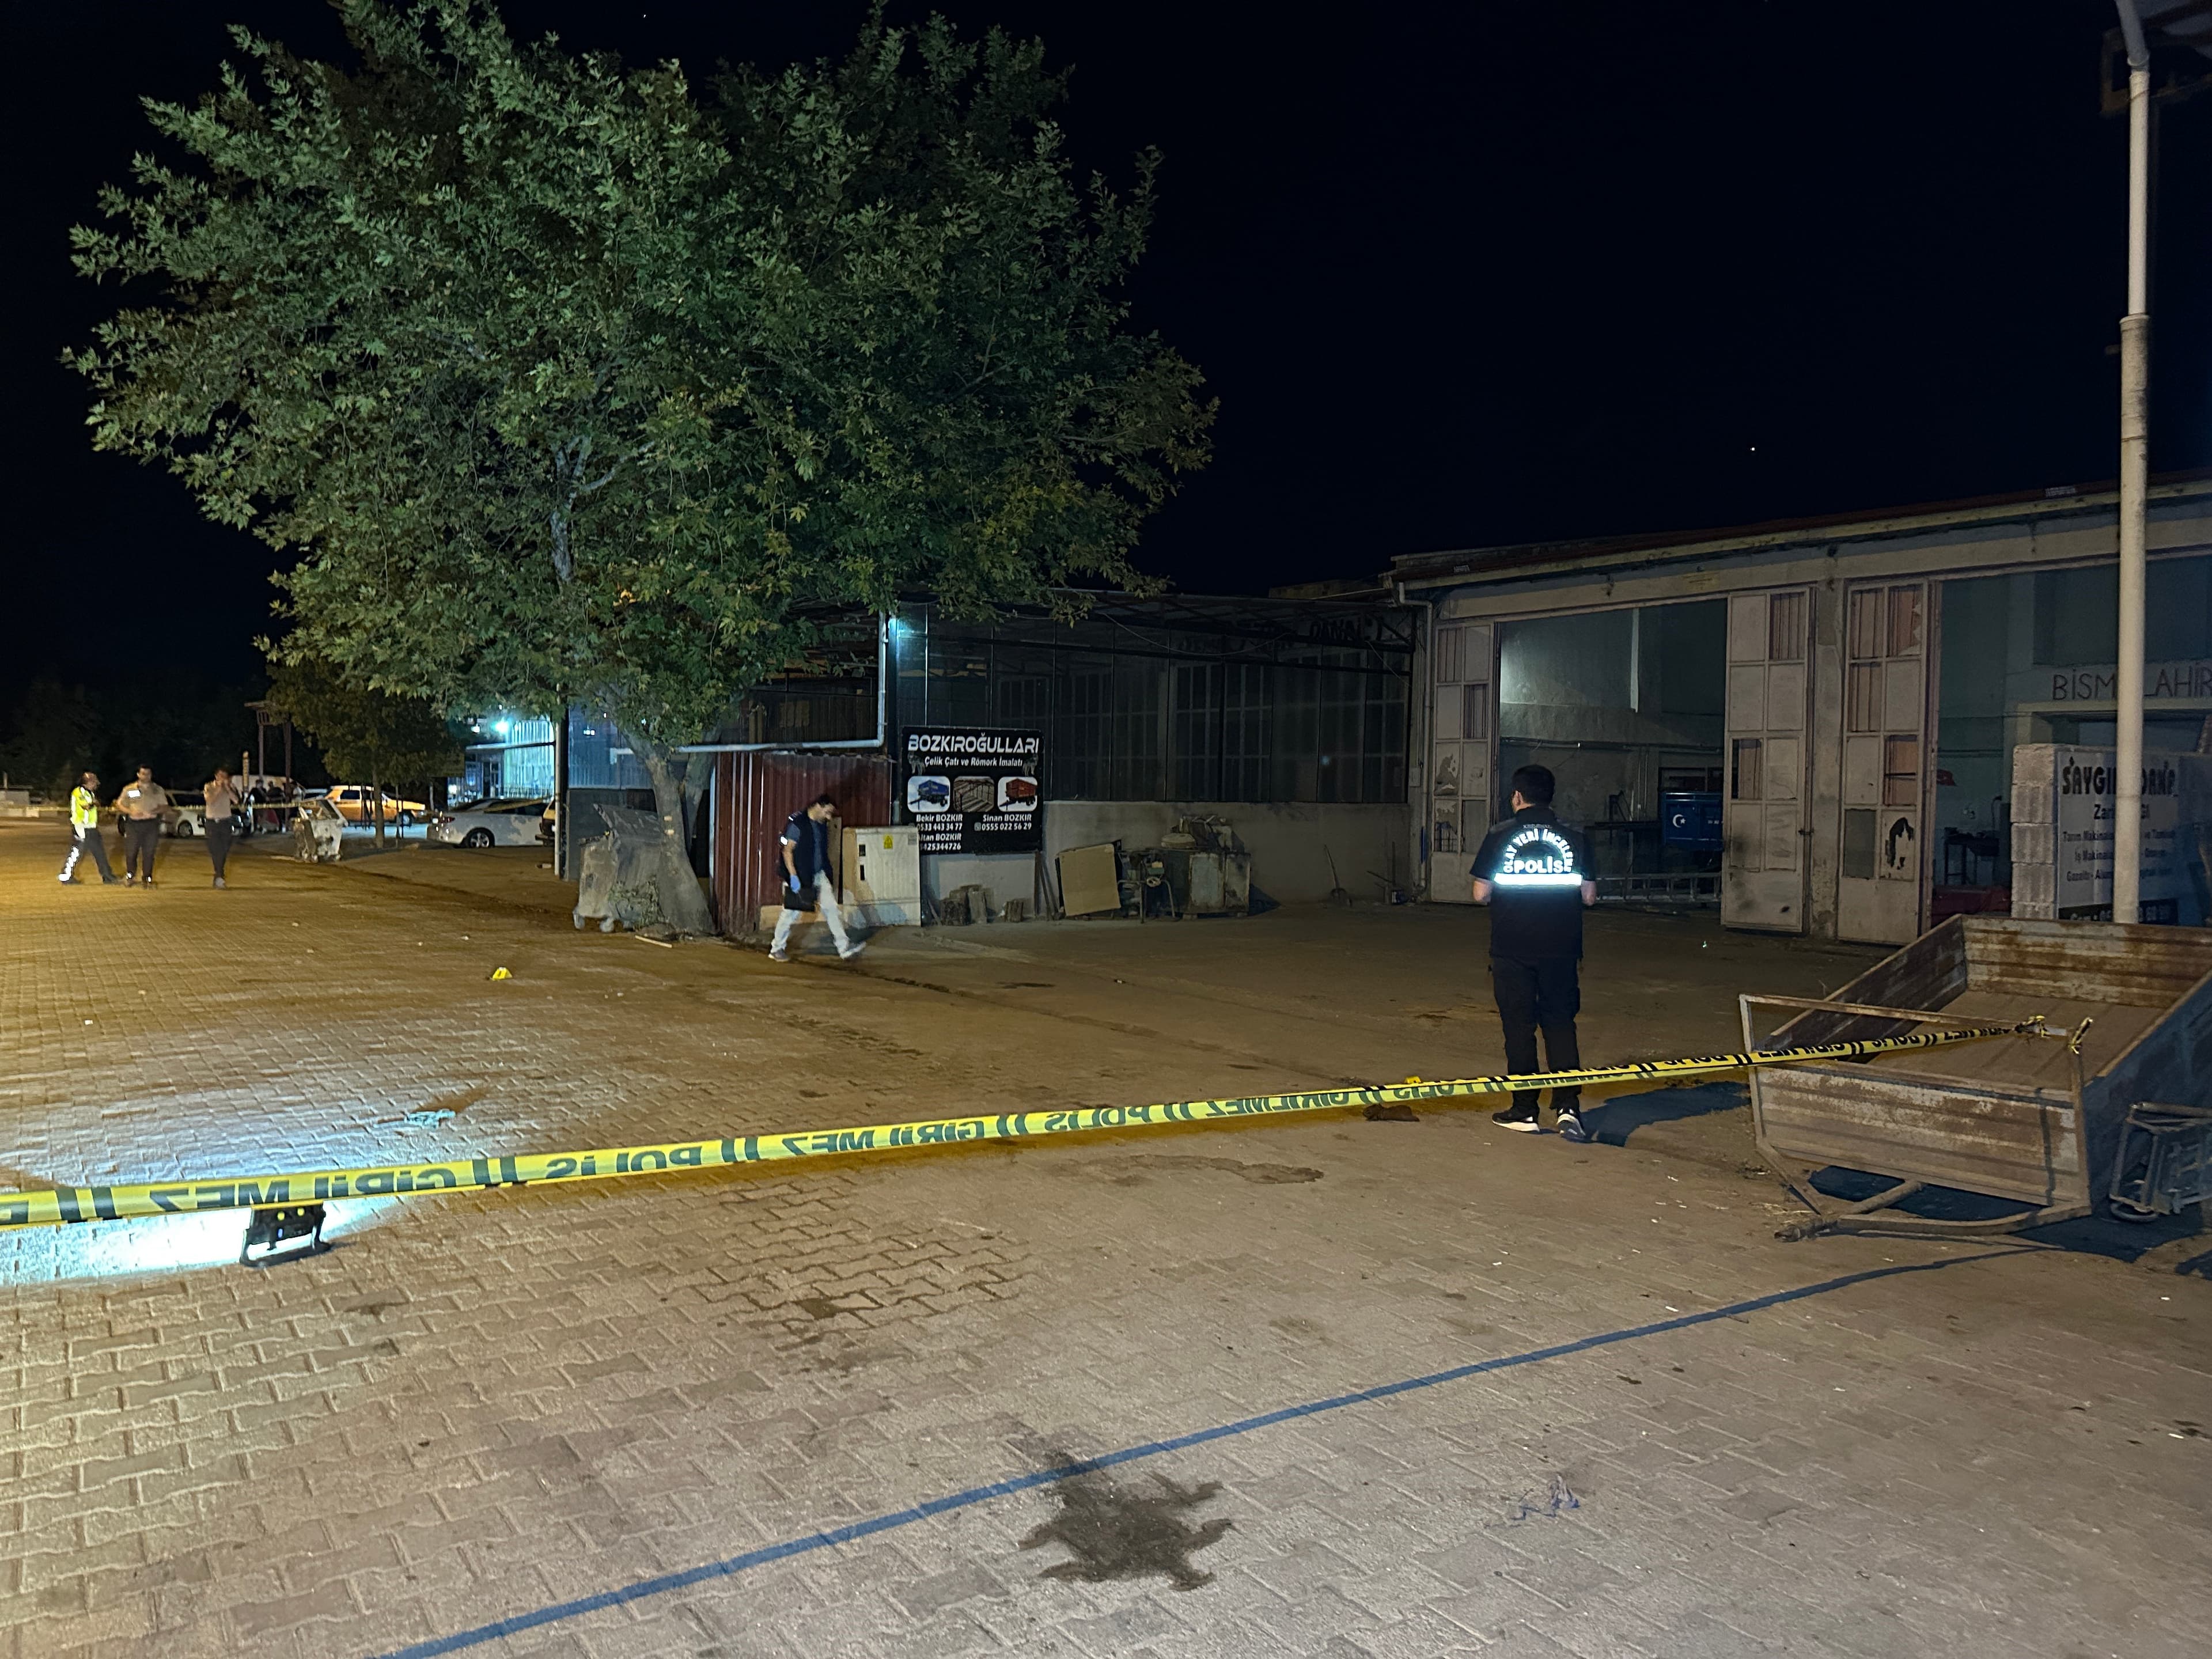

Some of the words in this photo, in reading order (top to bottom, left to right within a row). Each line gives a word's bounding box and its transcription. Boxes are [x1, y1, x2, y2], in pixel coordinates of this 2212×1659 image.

[908, 733, 1039, 753] BOZKIROĞULLARI
[925, 756, 942, 767] Çelik
[945, 756, 959, 767] Çatı
[971, 756, 997, 767] Römork
[999, 756, 1022, 767] İmalatı
[916, 814, 934, 822] Bekir
[936, 814, 963, 822] BOZKIR
[983, 814, 1002, 822] Sinan
[1004, 814, 1032, 823] BOZKIR
[982, 823, 998, 831] 0555
[1000, 823, 1012, 831] 022
[1014, 823, 1022, 831] 56
[1023, 823, 1032, 831] 29
[935, 833, 961, 841] BOZKIR
[1503, 844, 1517, 873] OLAY
[1514, 856, 1564, 873] POLİS
